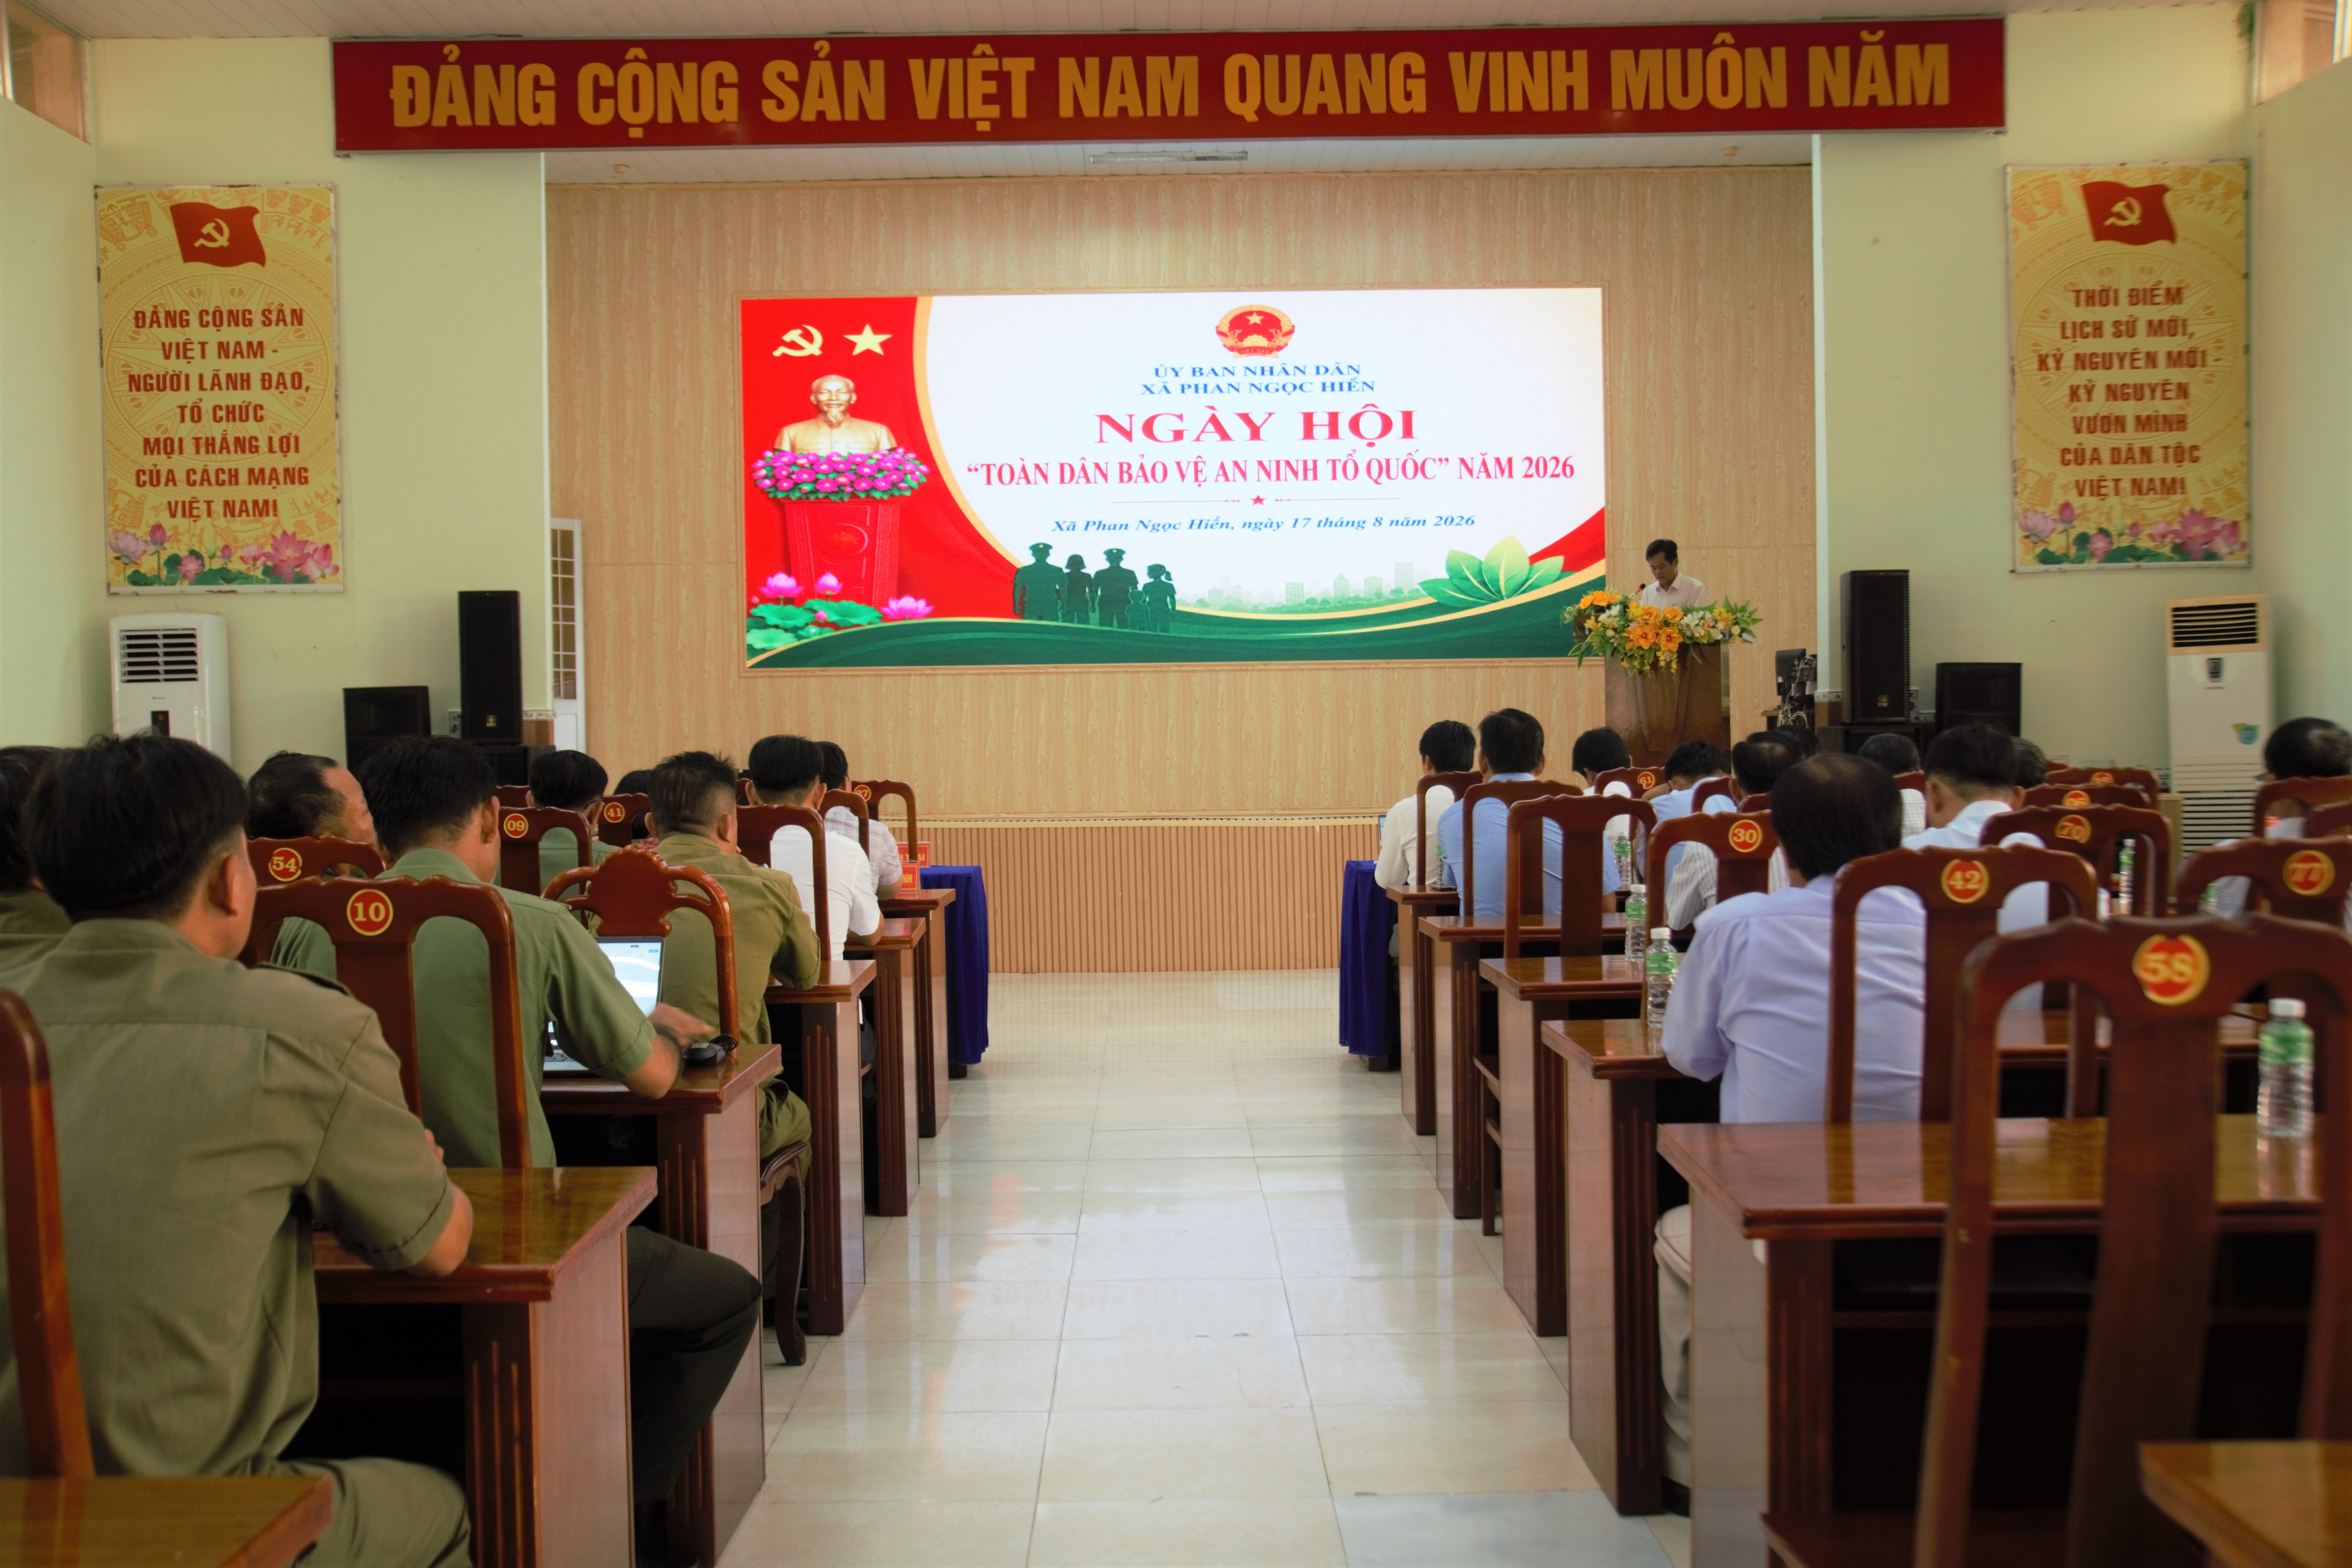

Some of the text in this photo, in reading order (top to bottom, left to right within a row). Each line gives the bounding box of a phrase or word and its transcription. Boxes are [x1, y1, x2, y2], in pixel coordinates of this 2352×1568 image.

[390, 31, 1949, 138] ĐẢNG CỘNG SẢN VIỆT NAM QUANG VINH MUÔN NĂM
[2073, 281, 2184, 307] THỜI ĐIỂM
[134, 303, 304, 332] ĐẢNG CỘNG SẢN
[2060, 316, 2193, 342] LỊCH SỬ MỚI,
[161, 338, 209, 364] VIỆT
[217, 341, 265, 359] NAM
[2037, 347, 2064, 371] KỶ
[2073, 349, 2157, 371] NGUYÊN
[2165, 346, 2207, 369] MỚI
[127, 369, 310, 394] NGƯỜI LÃNH ĐẠO,
[1154, 362, 1360, 377] ỦY BAN NHÂN DÂN
[1142, 377, 1374, 395] XÃ PHAN NGỌC HIỂN
[2068, 379, 2190, 403] KỶ NGUYÊN
[177, 398, 264, 424] TỔ CHỨC
[2072, 410, 2188, 434] VƯƠN MÌNH
[1094, 403, 1417, 448] NGÀY HỘI
[143, 430, 299, 459] MỌI THẮNG LỢI
[2060, 442, 2201, 466] CỦA DÂN TỘC
[135, 464, 309, 489] CỦA CÁCH MẠNG
[967, 448, 1575, 488] “TOÀN DÂN BẢO VỆ AN NINH TỔ QUỐC” NĂM 2026
[2074, 475, 2187, 500] VIỆT NAM!
[167, 496, 278, 523] VIỆT NAM!
[1052, 515, 1475, 533] Xã Phan Ngọc Hiển, ngày 17 tháng 8 năm 2026
[1640, 776, 1652, 784] 61
[607, 808, 622, 817] 41
[507, 820, 525, 831] 09
[1733, 828, 1757, 843] 30
[272, 856, 297, 872] 54
[2288, 863, 2327, 882] 77
[1949, 870, 1980, 889] 42
[354, 902, 385, 922] 10
